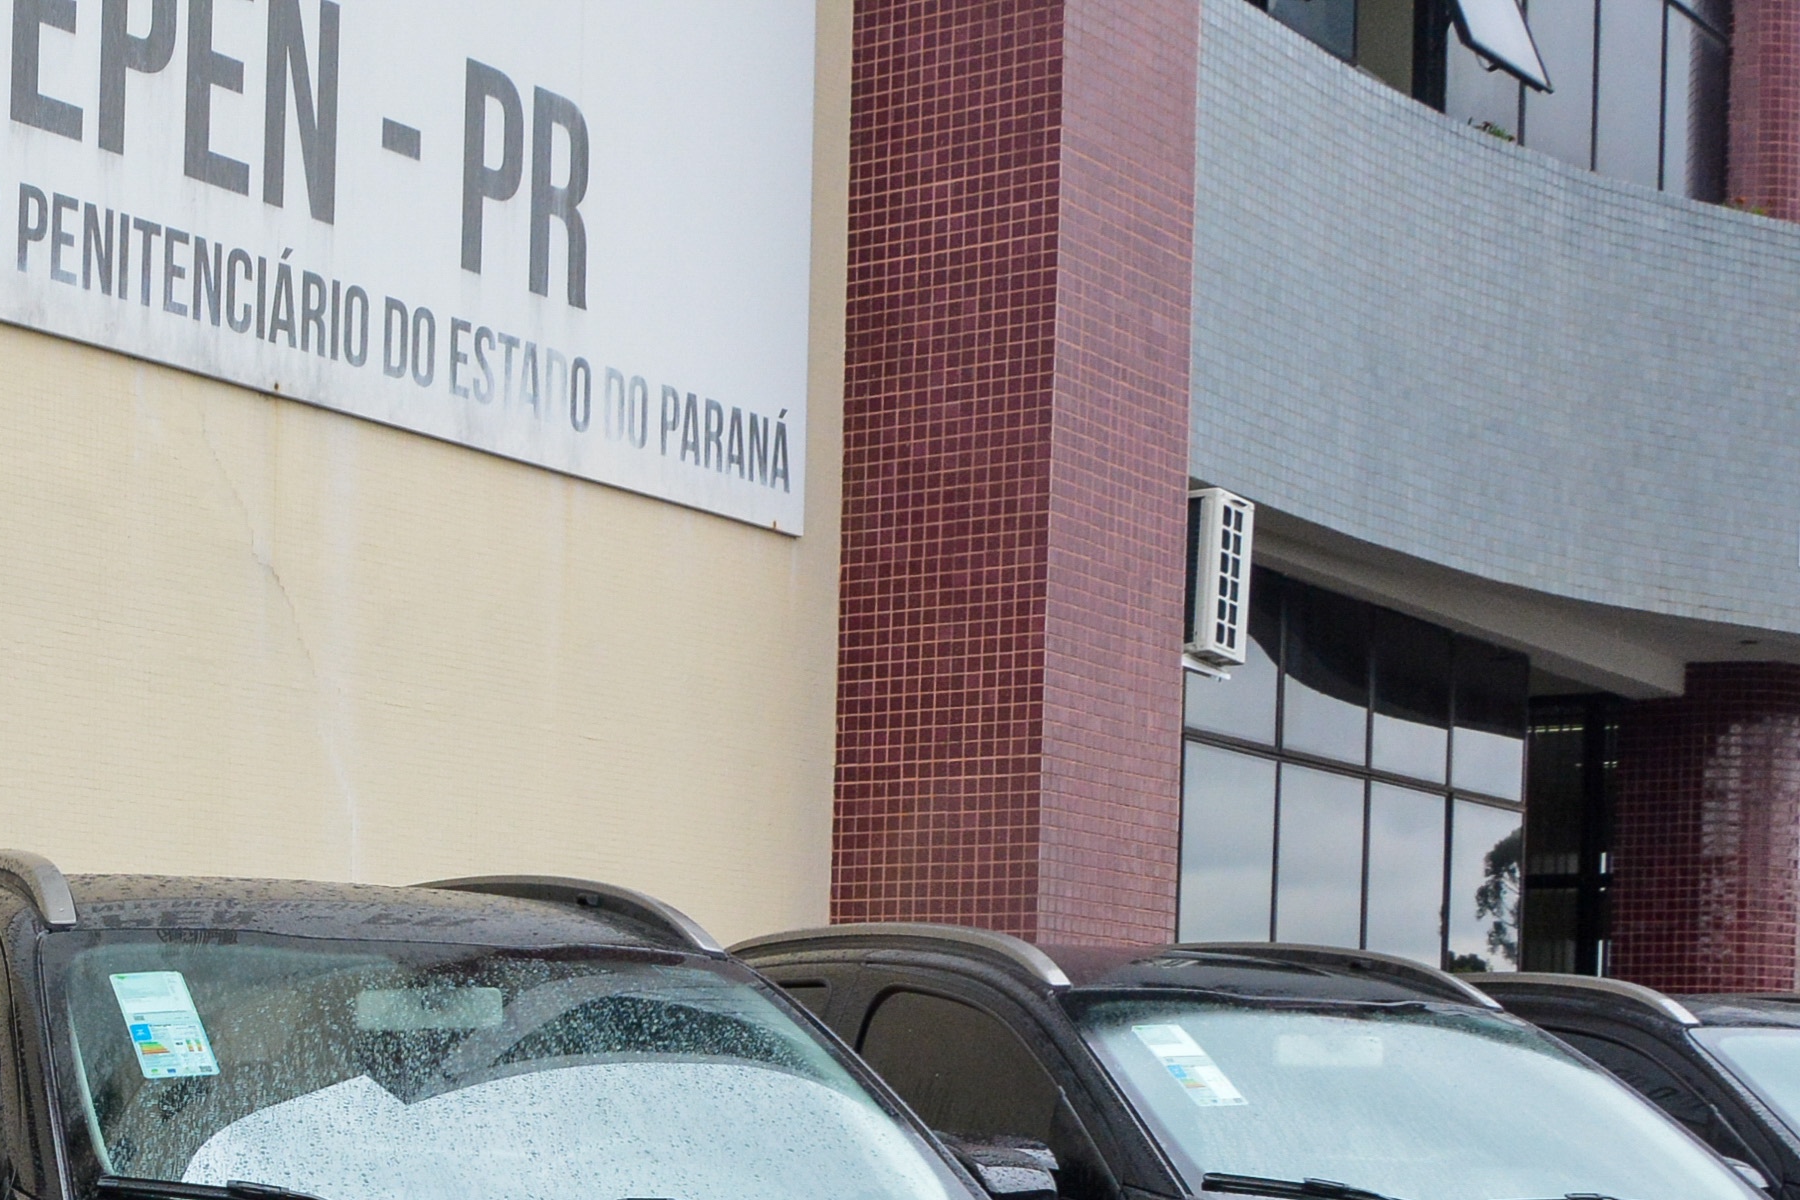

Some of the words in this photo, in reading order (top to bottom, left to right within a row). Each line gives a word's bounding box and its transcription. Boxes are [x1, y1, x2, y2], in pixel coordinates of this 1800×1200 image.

[460, 57, 590, 311] PR
[17, 182, 369, 368] PENITENCIÁRIO
[383, 295, 436, 388] DO
[448, 316, 591, 433] ESTADO
[604, 366, 648, 450] DO
[659, 384, 791, 493] PARANÁ
